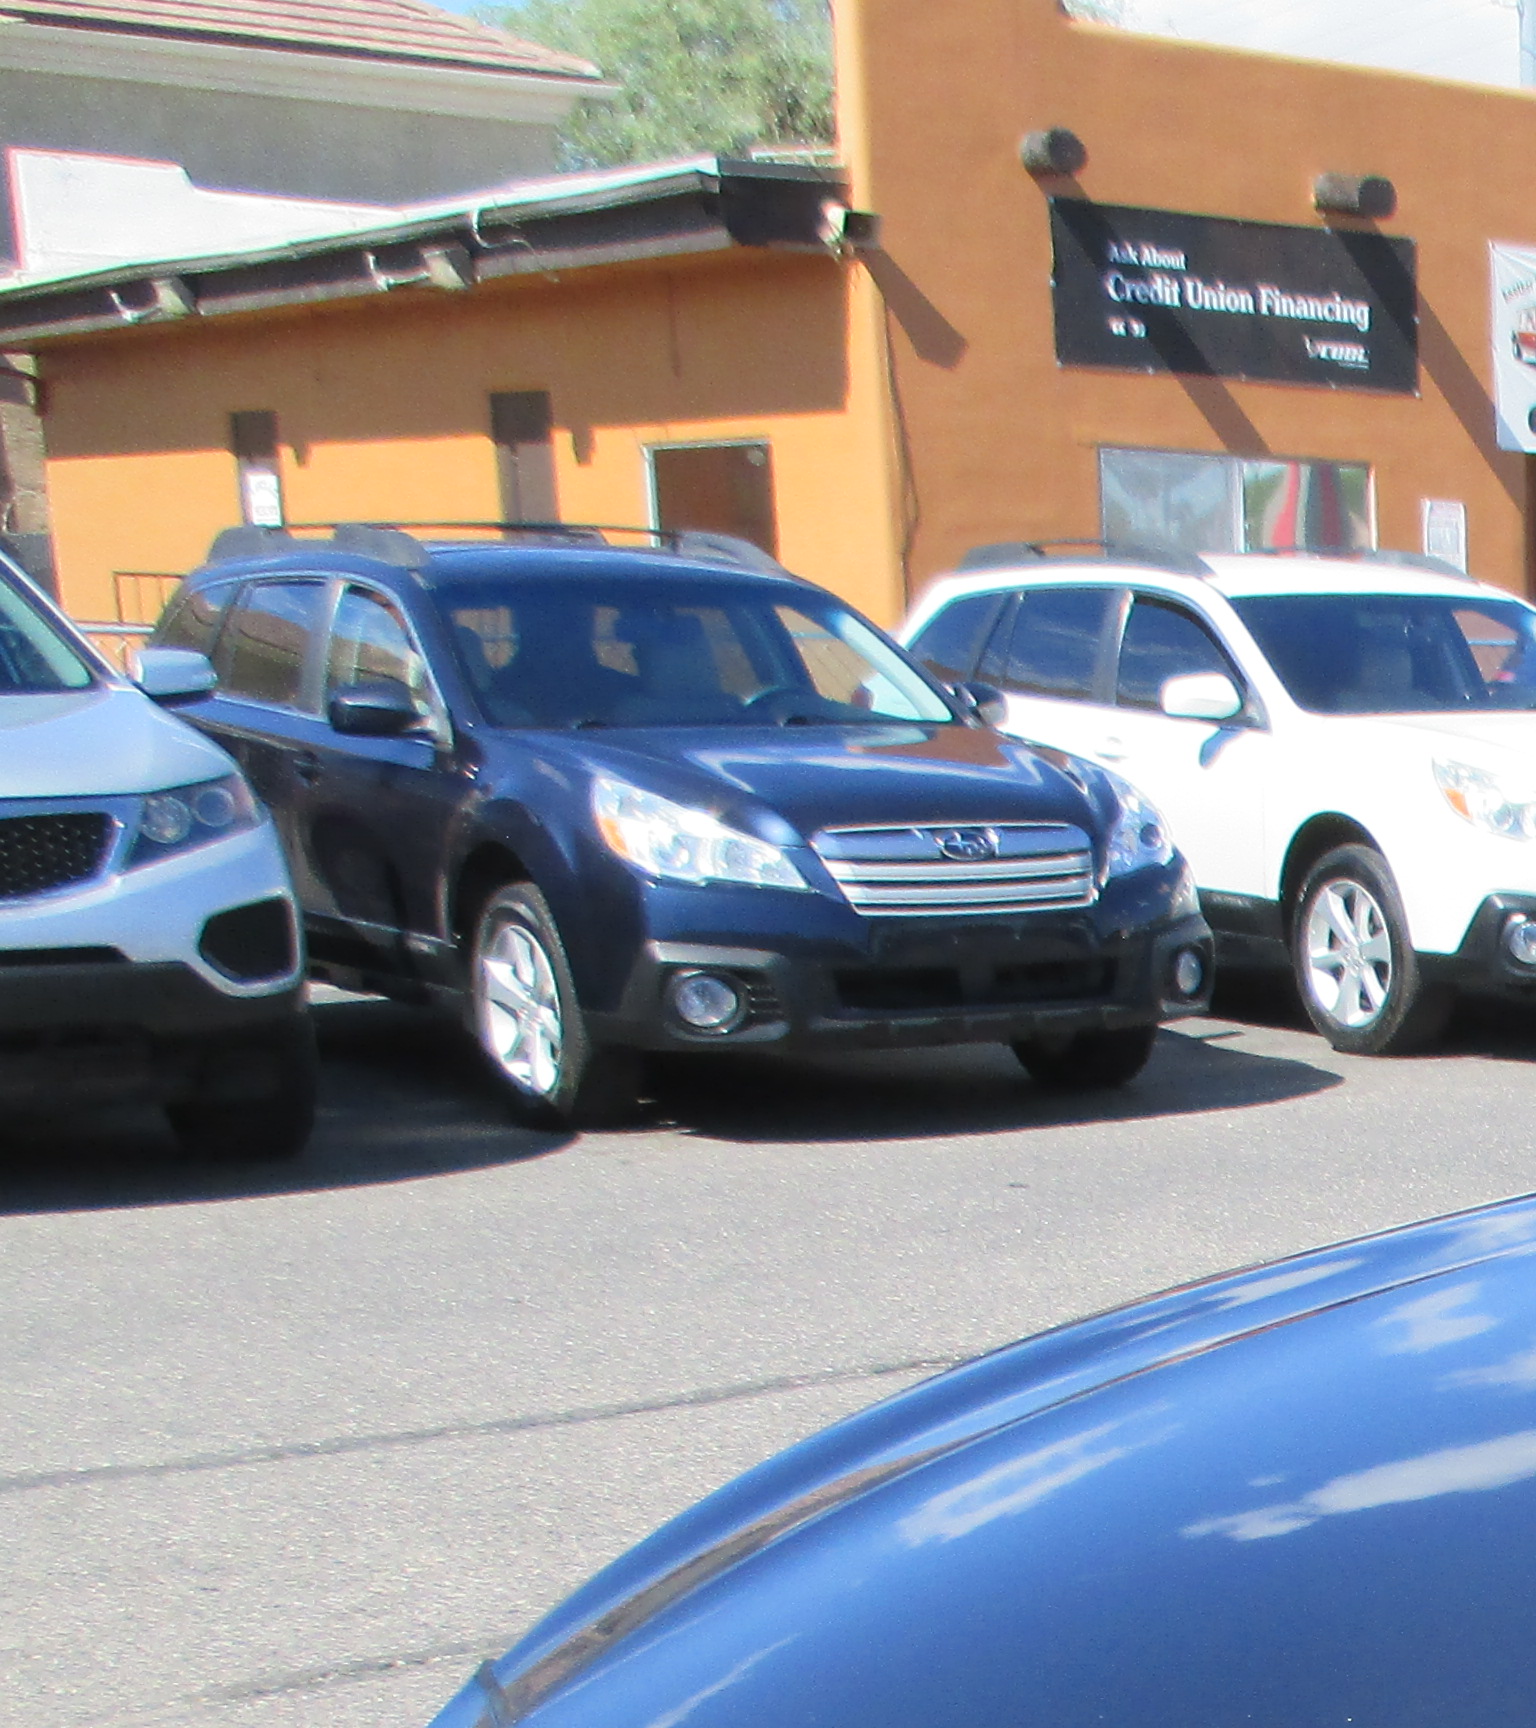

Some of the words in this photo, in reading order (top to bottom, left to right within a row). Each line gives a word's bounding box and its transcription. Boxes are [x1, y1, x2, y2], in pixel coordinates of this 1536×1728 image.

[1108, 240, 1139, 266] Ask
[1140, 242, 1187, 271] About
[1105, 270, 1182, 308] Credit
[1184, 276, 1256, 315] Union
[1257, 283, 1371, 333] Financing
